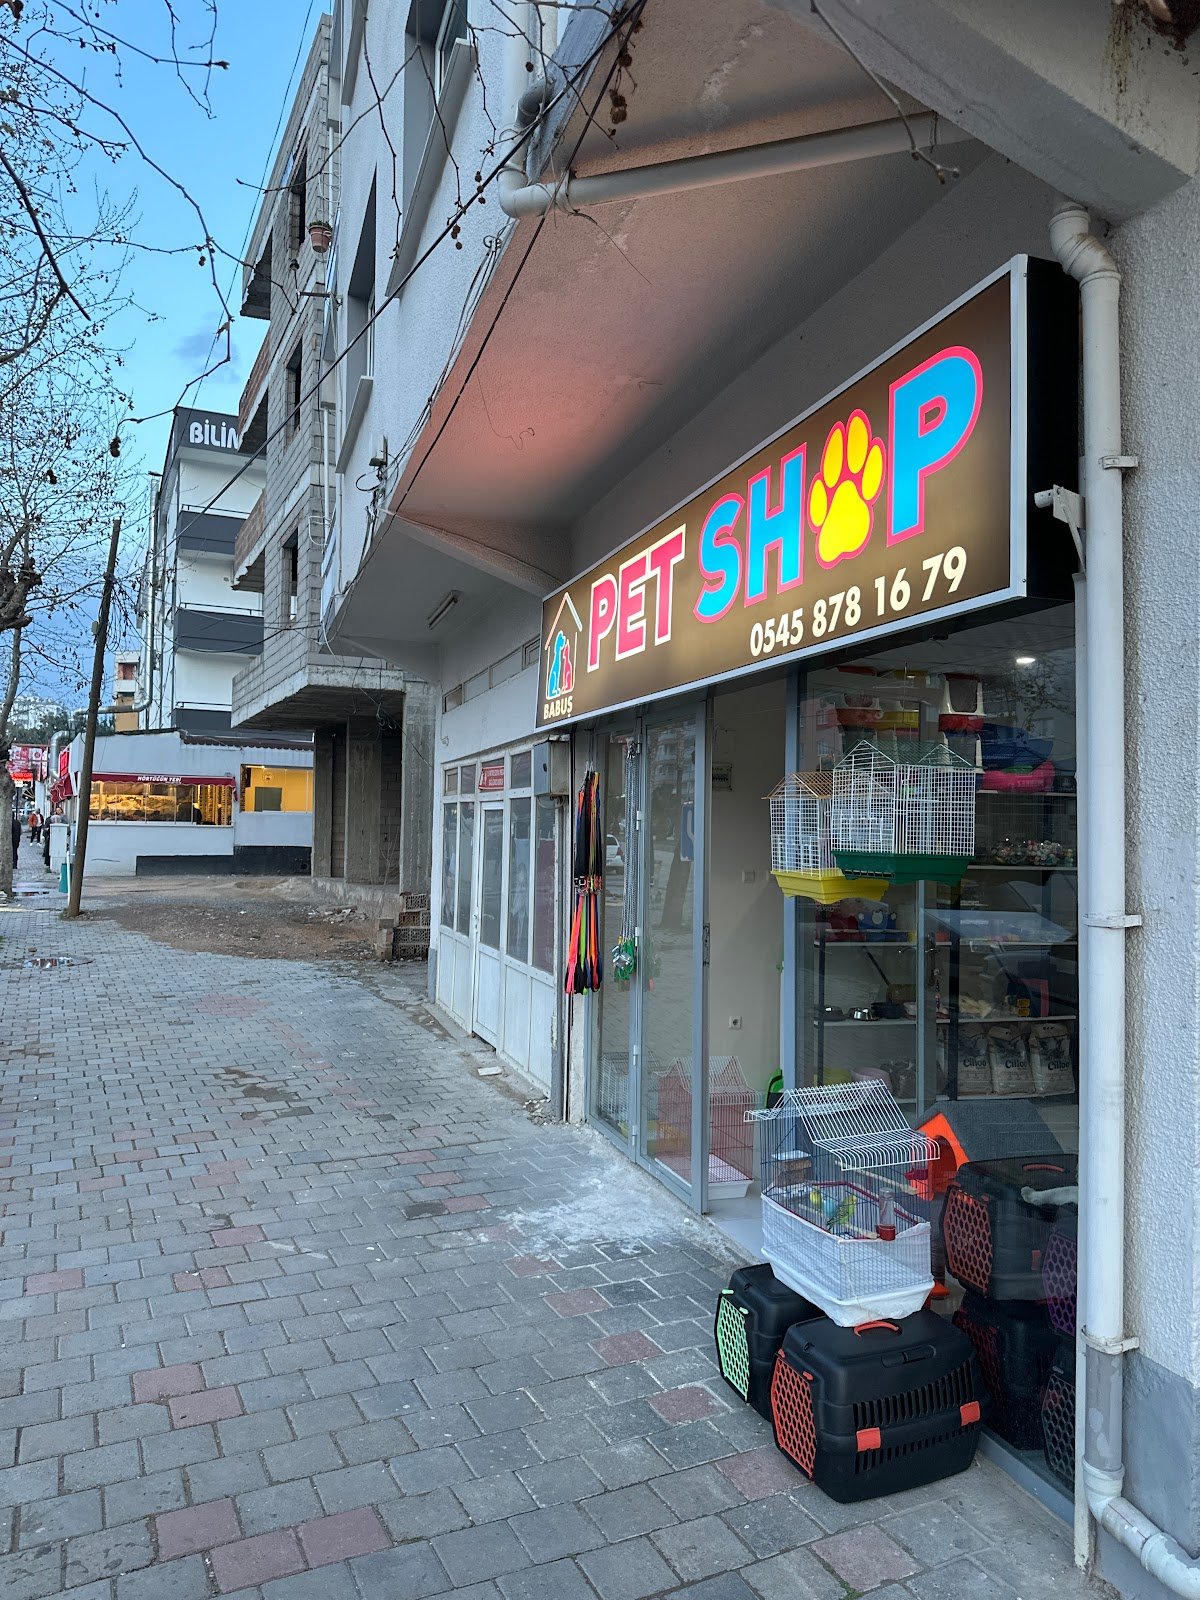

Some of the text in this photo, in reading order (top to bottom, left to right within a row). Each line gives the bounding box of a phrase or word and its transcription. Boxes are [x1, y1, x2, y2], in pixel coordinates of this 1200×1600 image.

[587, 523, 687, 673] PET
[750, 546, 967, 657] 0545 878 16 79
[543, 696, 573, 720] BABUŞ
